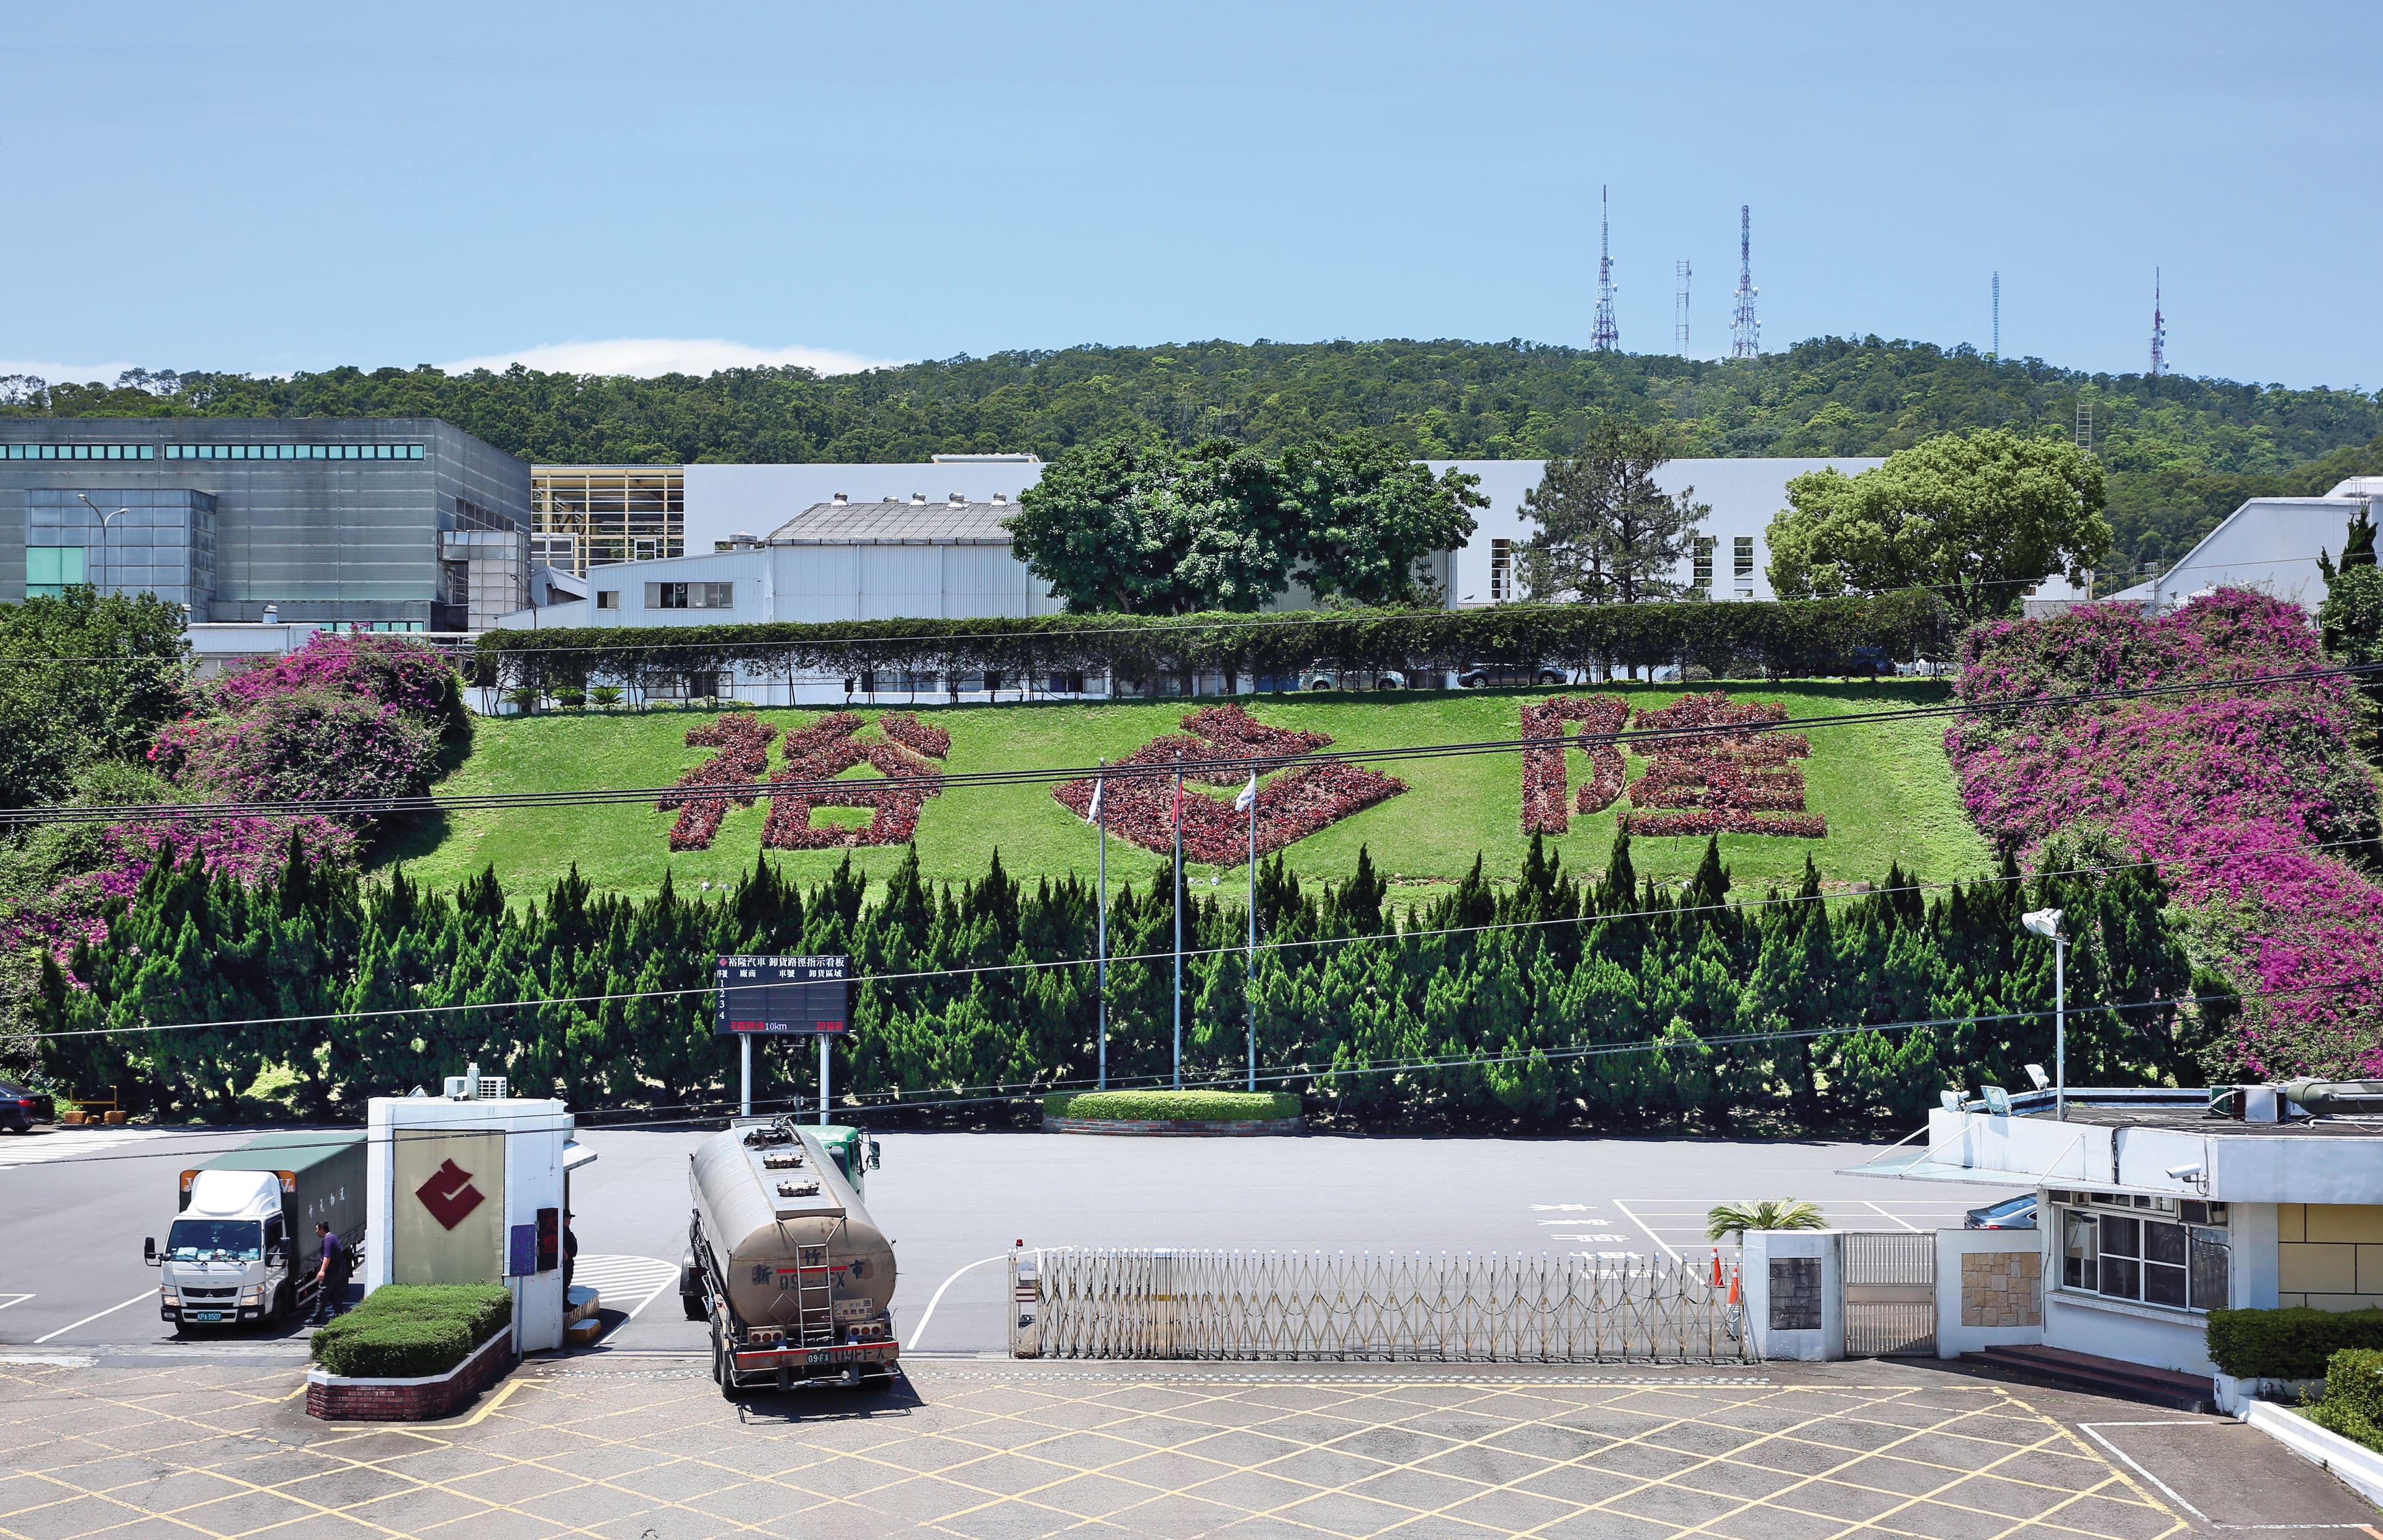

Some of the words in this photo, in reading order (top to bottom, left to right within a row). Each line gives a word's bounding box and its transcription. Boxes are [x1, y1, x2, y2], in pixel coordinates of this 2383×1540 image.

[729, 957, 766, 967] 裕隆汽車
[769, 957, 845, 967] 卸貨路徑指示看板
[740, 970, 756, 978] 廠商
[779, 970, 795, 978] 車號
[809, 970, 843, 978] 卸貨區域
[719, 1000, 725, 1008] 3
[719, 1011, 725, 1019] 4
[765, 1023, 787, 1031] 10km
